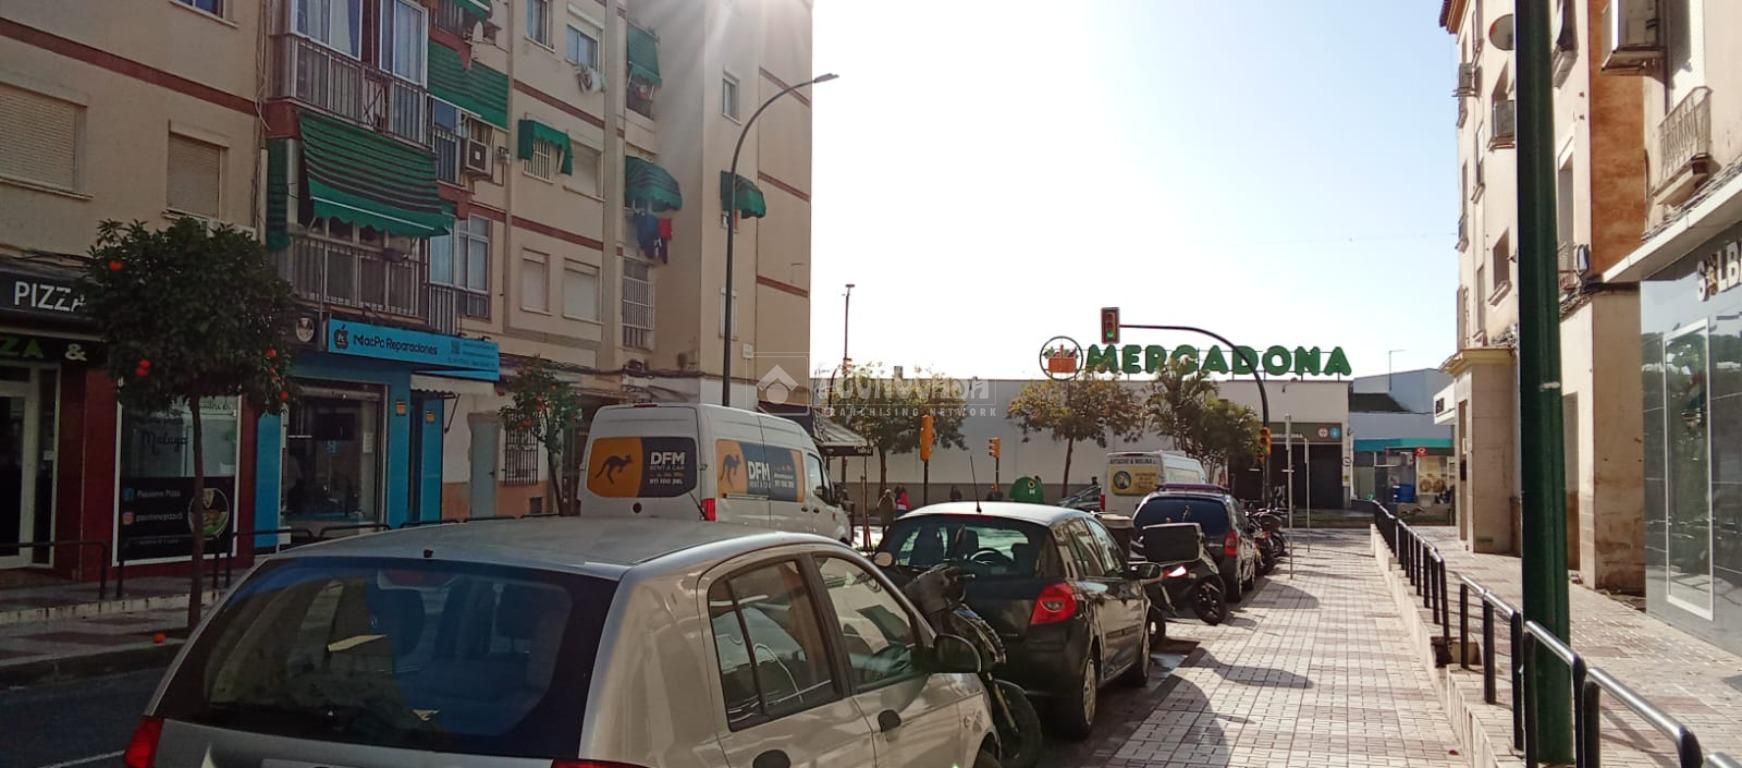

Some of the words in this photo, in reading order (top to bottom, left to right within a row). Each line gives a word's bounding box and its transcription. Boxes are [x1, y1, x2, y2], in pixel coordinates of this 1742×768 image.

[386, 337, 438, 356] Reparaciones
[1085, 344, 1352, 376] MERCADONA
[650, 451, 686, 465] DFM
[747, 460, 771, 481] DFM
